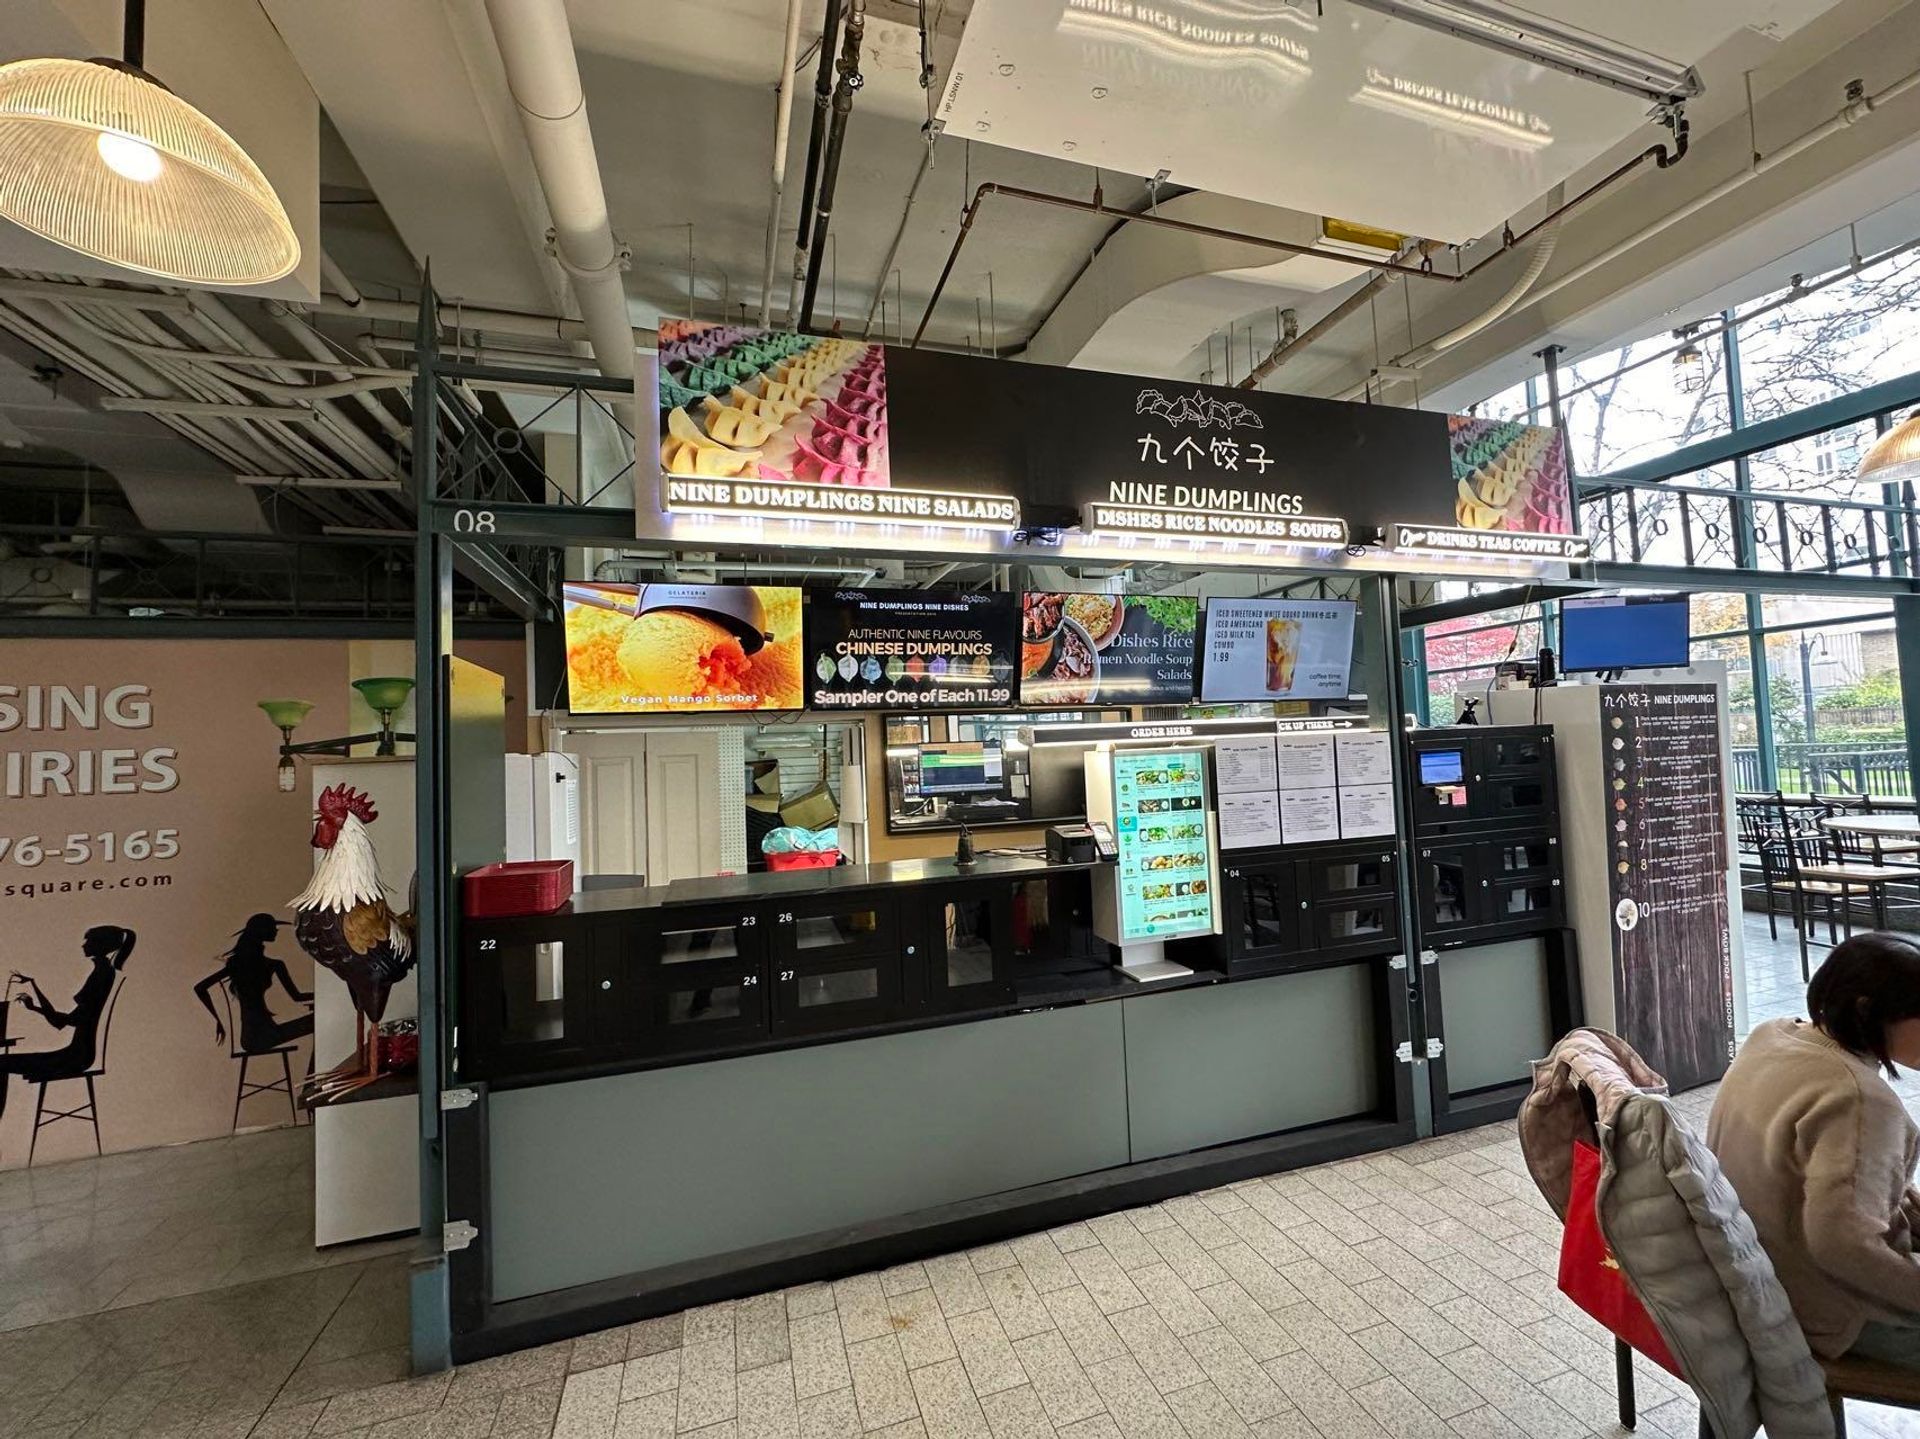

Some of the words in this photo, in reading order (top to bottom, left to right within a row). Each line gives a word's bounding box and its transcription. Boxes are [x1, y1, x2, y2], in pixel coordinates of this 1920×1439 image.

[1137, 433, 1275, 474] 九个饺子
[669, 481, 731, 504] NINE
[734, 486, 875, 512] DUMPLINGS
[877, 494, 931, 515] NINE
[933, 498, 1014, 520] SALADS
[1109, 481, 1168, 506] NINE
[1174, 486, 1304, 515] DUMPLINGS
[454, 509, 496, 533] 08
[1097, 510, 1164, 529] DISHES
[1164, 513, 1208, 531] RICE
[1208, 516, 1287, 536] NOODLES
[1289, 522, 1342, 539] SOUPS
[1427, 531, 1478, 549] DRINKS
[1478, 535, 1511, 551] TEAS
[1511, 538, 1561, 553] COFFEE
[860, 602, 878, 610] NINE
[879, 602, 923, 610] DUMPLINGS
[1215, 620, 1228, 628] ICED
[848, 629, 906, 640] AUTHENTIC
[907, 630, 931, 640] NINE
[933, 630, 983, 640] FLAVOURS
[1111, 633, 1159, 648] Dishes
[1162, 633, 1193, 648] Rice
[1214, 630, 1228, 638] ICED
[1229, 630, 1244, 639] MILK
[836, 642, 904, 655] CHINESE
[906, 643, 993, 655] DUMPLINGS
[1124, 652, 1163, 665] Noodle
[1165, 653, 1193, 667] Soup
[1213, 652, 1229, 662] 1.99
[1156, 668, 1192, 680] Salads
[621, 694, 663, 704] Vegan
[668, 693, 711, 704] Mango
[716, 692, 758, 703] Sorbet
[814, 689, 884, 707] Sampler
[885, 690, 919, 703] One
[920, 690, 937, 703] of
[938, 689, 975, 703] Each
[976, 689, 1010, 703] 11.99
[1604, 692, 1651, 709] 九个饺子
[1654, 695, 1673, 705] NINE
[1673, 694, 1716, 704] DUMPLINGS
[1306, 720, 1334, 730] THERE
[1131, 727, 1165, 738] ORDER
[1165, 726, 1193, 736] HERE
[1635, 736, 1642, 749] 2
[1637, 777, 1645, 789] 4
[1639, 797, 1645, 809] 5
[1639, 818, 1645, 830] 6
[1640, 838, 1646, 851] 7
[1640, 858, 1647, 871] 8
[1230, 869, 1240, 877] 04
[1638, 902, 1650, 918] 10
[742, 916, 756, 926] 23
[779, 912, 793, 923] 26
[480, 940, 496, 950] 22
[743, 975, 757, 986] 24
[780, 971, 794, 981] 27
